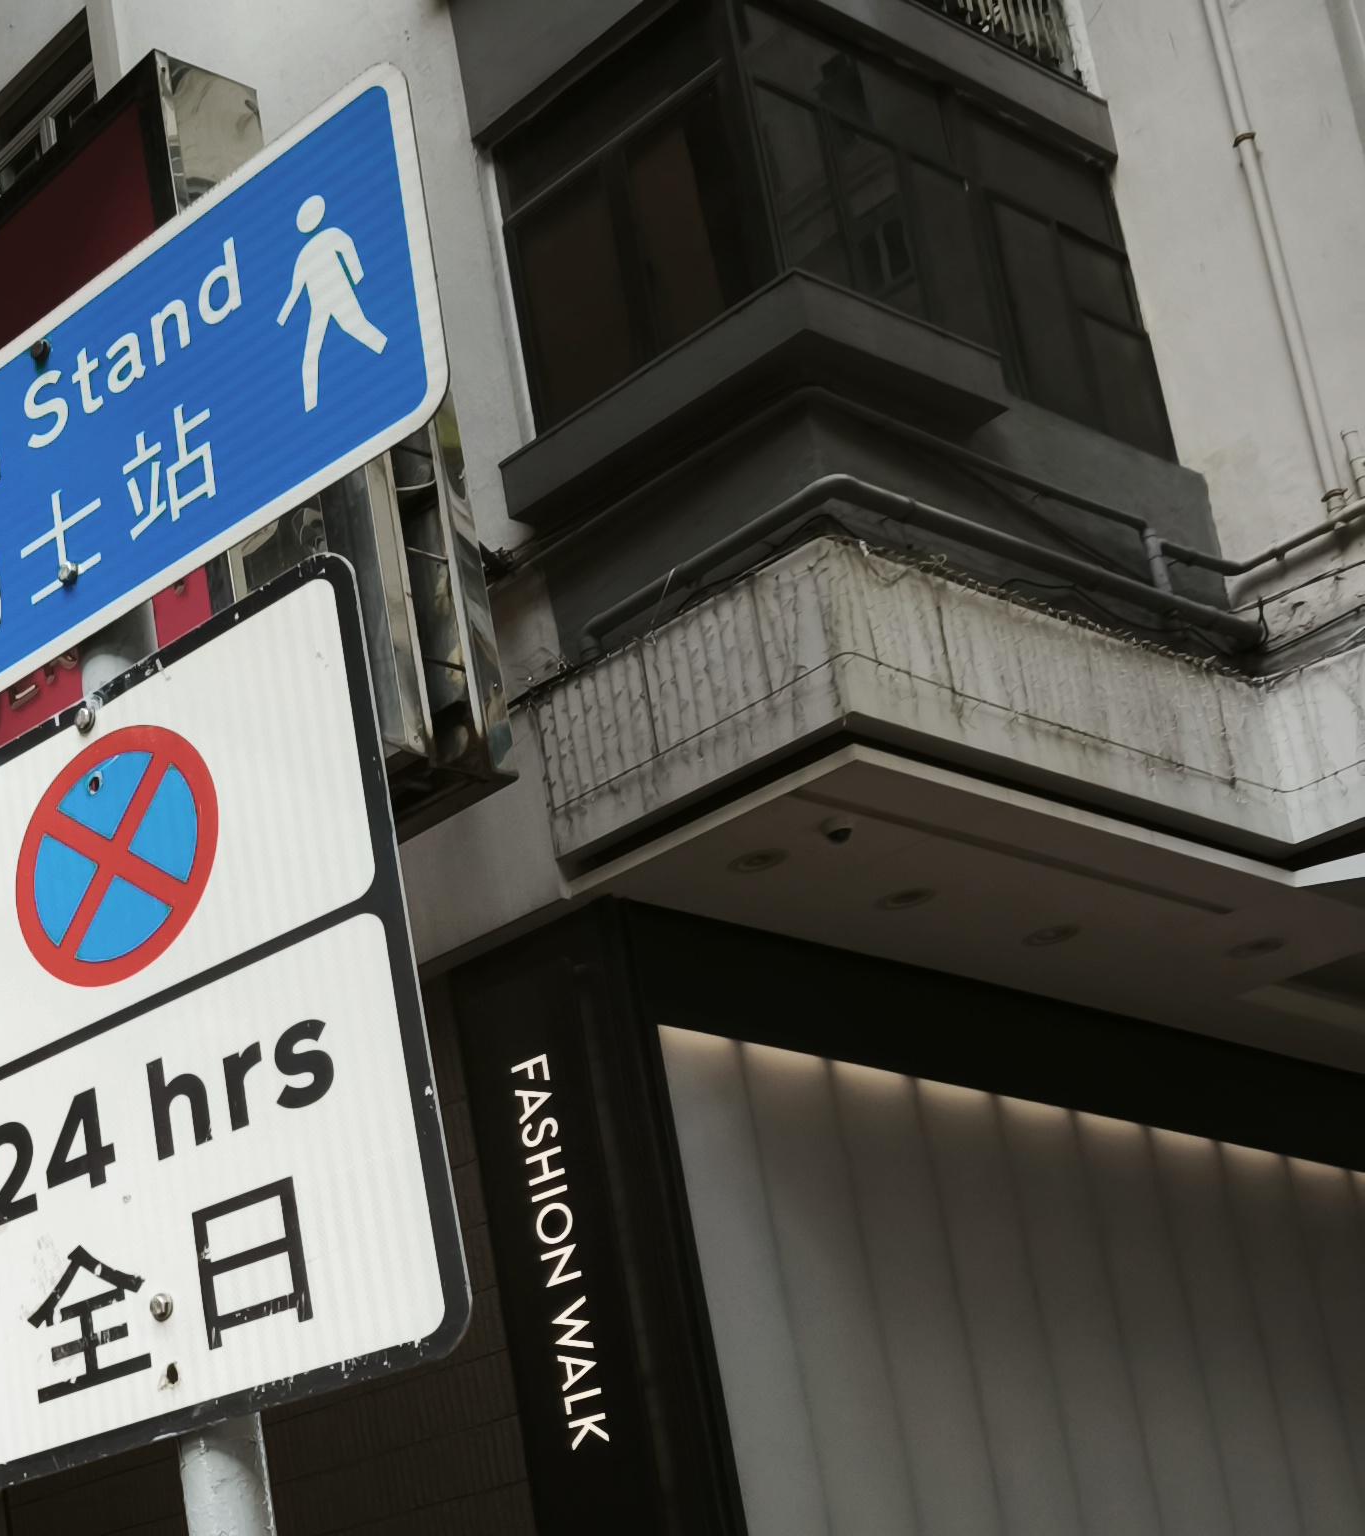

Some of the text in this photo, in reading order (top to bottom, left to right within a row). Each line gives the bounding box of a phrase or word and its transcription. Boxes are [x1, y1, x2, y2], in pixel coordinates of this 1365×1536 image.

[23, 236, 244, 450] Stand
[145, 1018, 335, 1161] hrs
[27, 1175, 314, 1404] 全日
[510, 1053, 610, 1451] FASHION WALK
